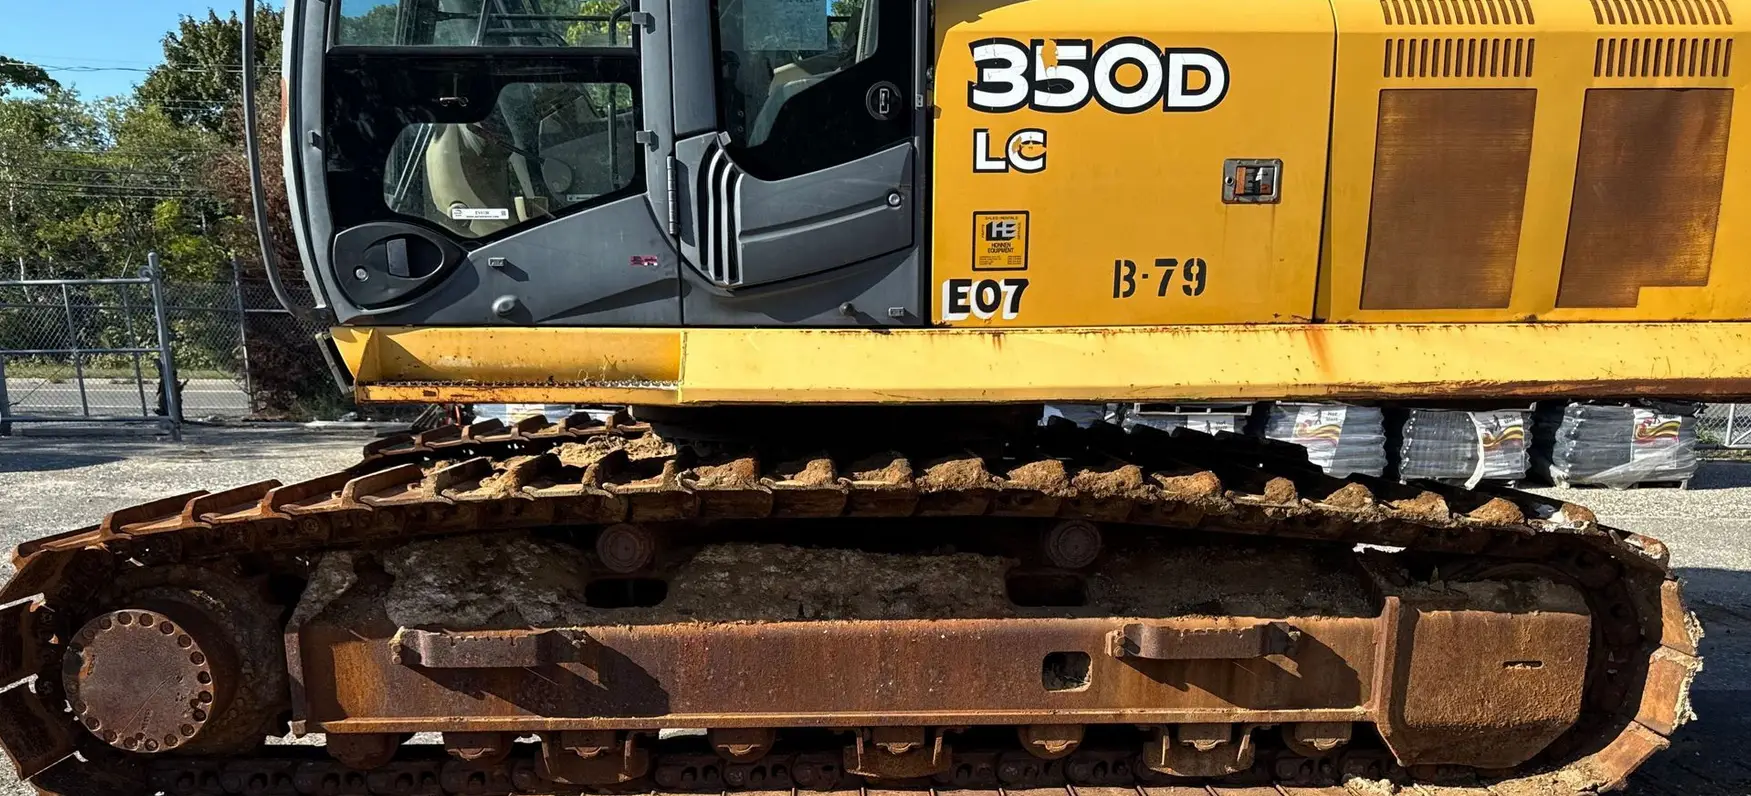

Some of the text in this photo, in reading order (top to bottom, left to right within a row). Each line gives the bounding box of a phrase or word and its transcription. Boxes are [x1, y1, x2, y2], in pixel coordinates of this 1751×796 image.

[968, 37, 1229, 114] 350D
[973, 128, 1047, 173] LC
[943, 279, 1029, 320] E07
[1113, 258, 1207, 298] B-79
